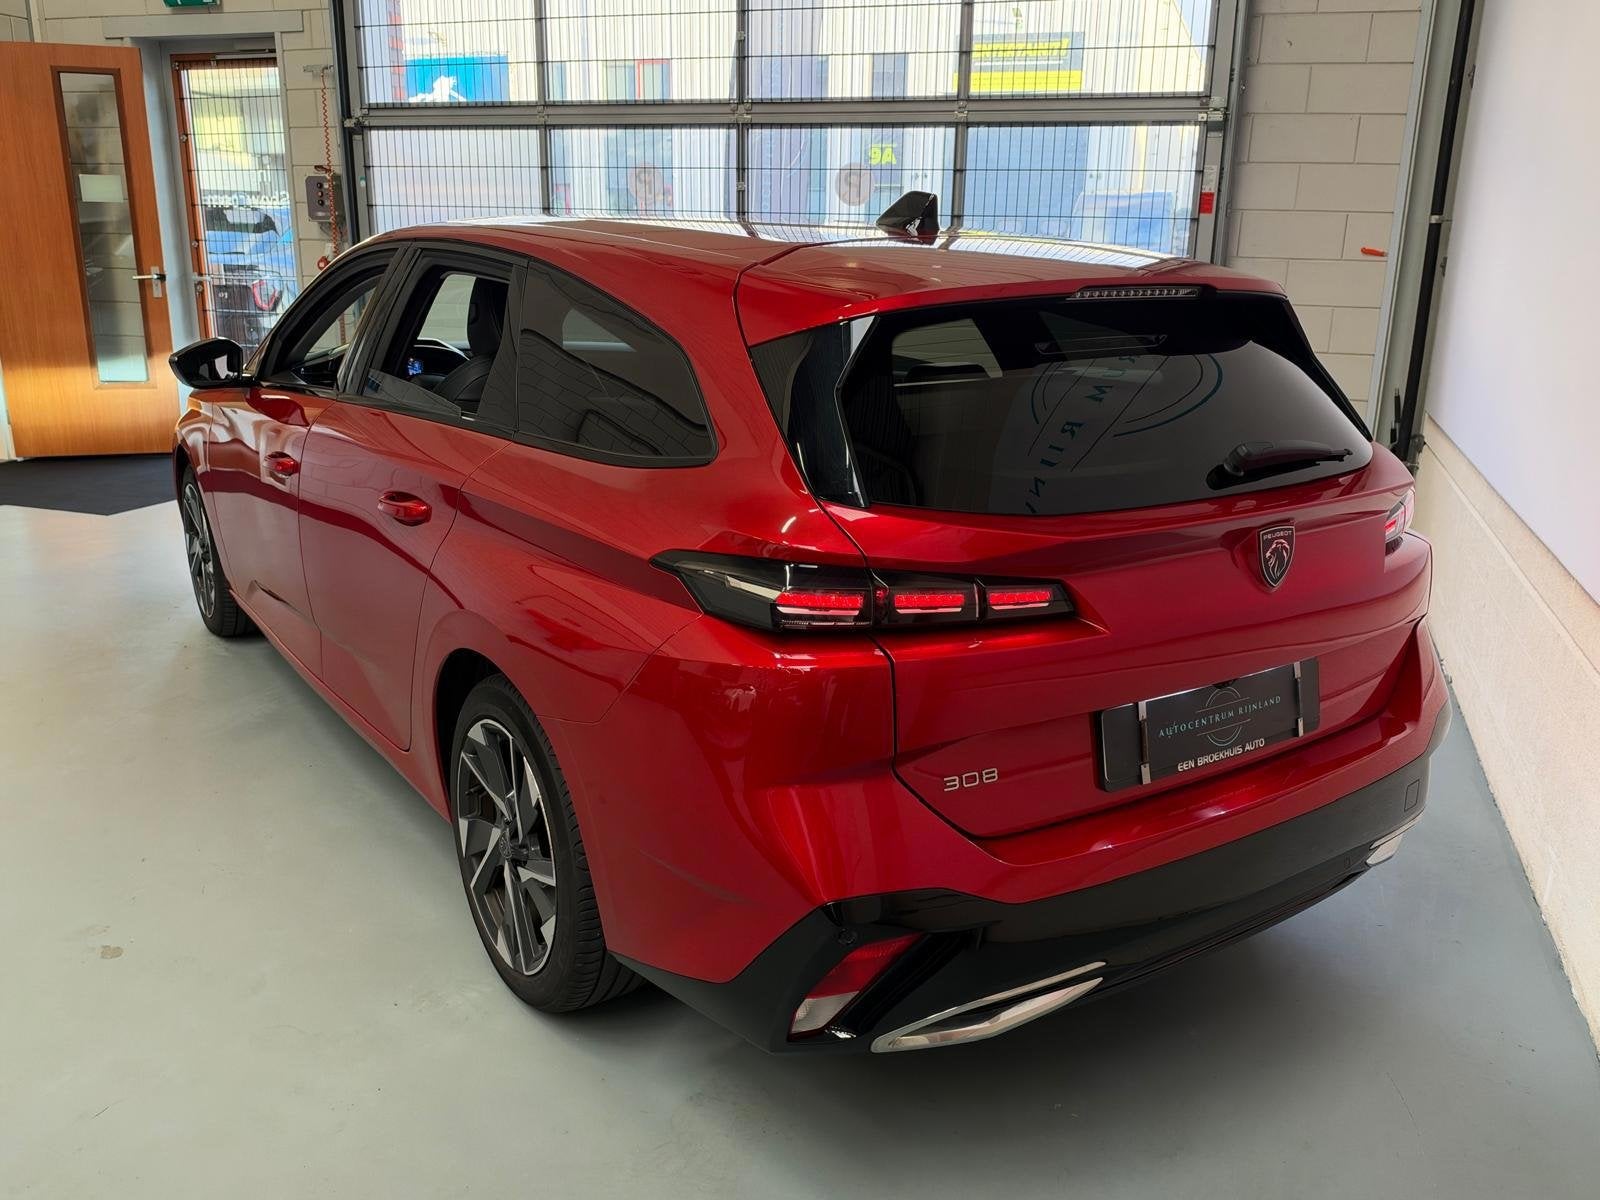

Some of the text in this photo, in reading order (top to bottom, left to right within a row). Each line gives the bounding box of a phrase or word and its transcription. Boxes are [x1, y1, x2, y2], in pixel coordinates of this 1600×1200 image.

[1263, 531, 1292, 540] PEUGEOT
[1158, 695, 1281, 738] AUTOCENTRUM RIJNLAND
[1177, 738, 1266, 772] EEN BROEKHUIS AUTO
[943, 767, 999, 792] 308
